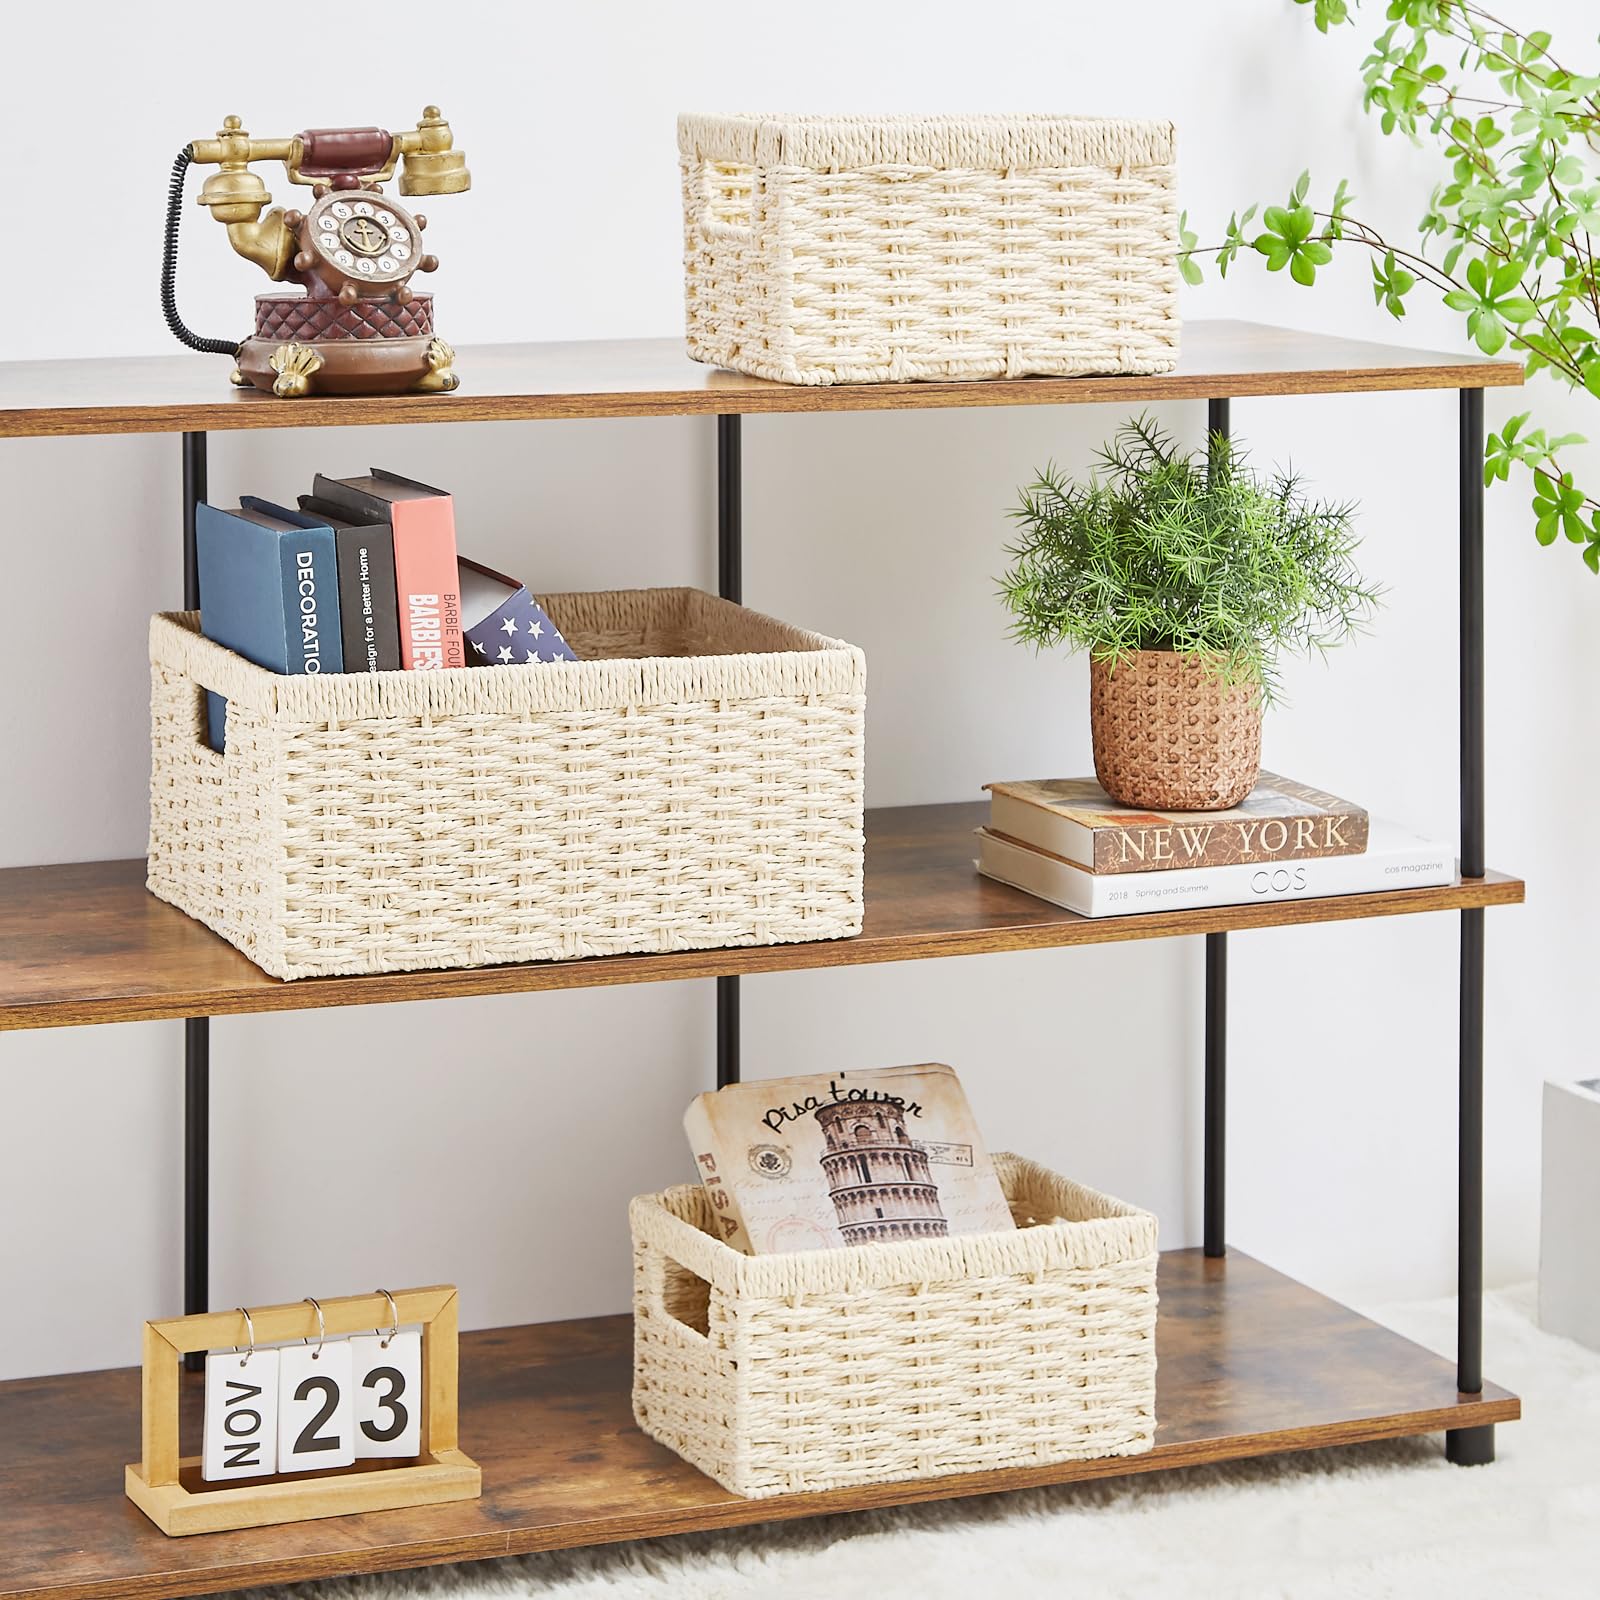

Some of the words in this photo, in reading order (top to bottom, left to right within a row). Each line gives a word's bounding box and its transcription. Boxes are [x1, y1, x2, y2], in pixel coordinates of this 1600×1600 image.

[337, 207, 347, 217] 5
[359, 207, 367, 215] 4
[324, 219, 333, 229] 6
[380, 215, 389, 225] 3
[324, 238, 332, 246] 7
[393, 231, 403, 240] 2
[339, 255, 347, 264] 8
[383, 261, 391, 269] 0
[361, 262, 370, 272] 9
[359, 547, 369, 581] Home
[362, 582, 373, 615] Better
[296, 551, 321, 674] DECORATIO
[443, 594, 459, 636] BARBIE
[365, 616, 373, 624] a
[364, 626, 375, 642] for
[366, 643, 378, 673] esign
[1119, 826, 1215, 862] NEW
[1236, 816, 1350, 854] YORK
[1384, 866, 1400, 875] cos
[1401, 861, 1443, 875] magazine
[1250, 867, 1307, 894] COS
[1108, 890, 1128, 901] 2018
[1135, 888, 1161, 898] Spring
[1162, 886, 1178, 896] and
[698, 1152, 739, 1239] PISA
[223, 1380, 262, 1469] NOV
